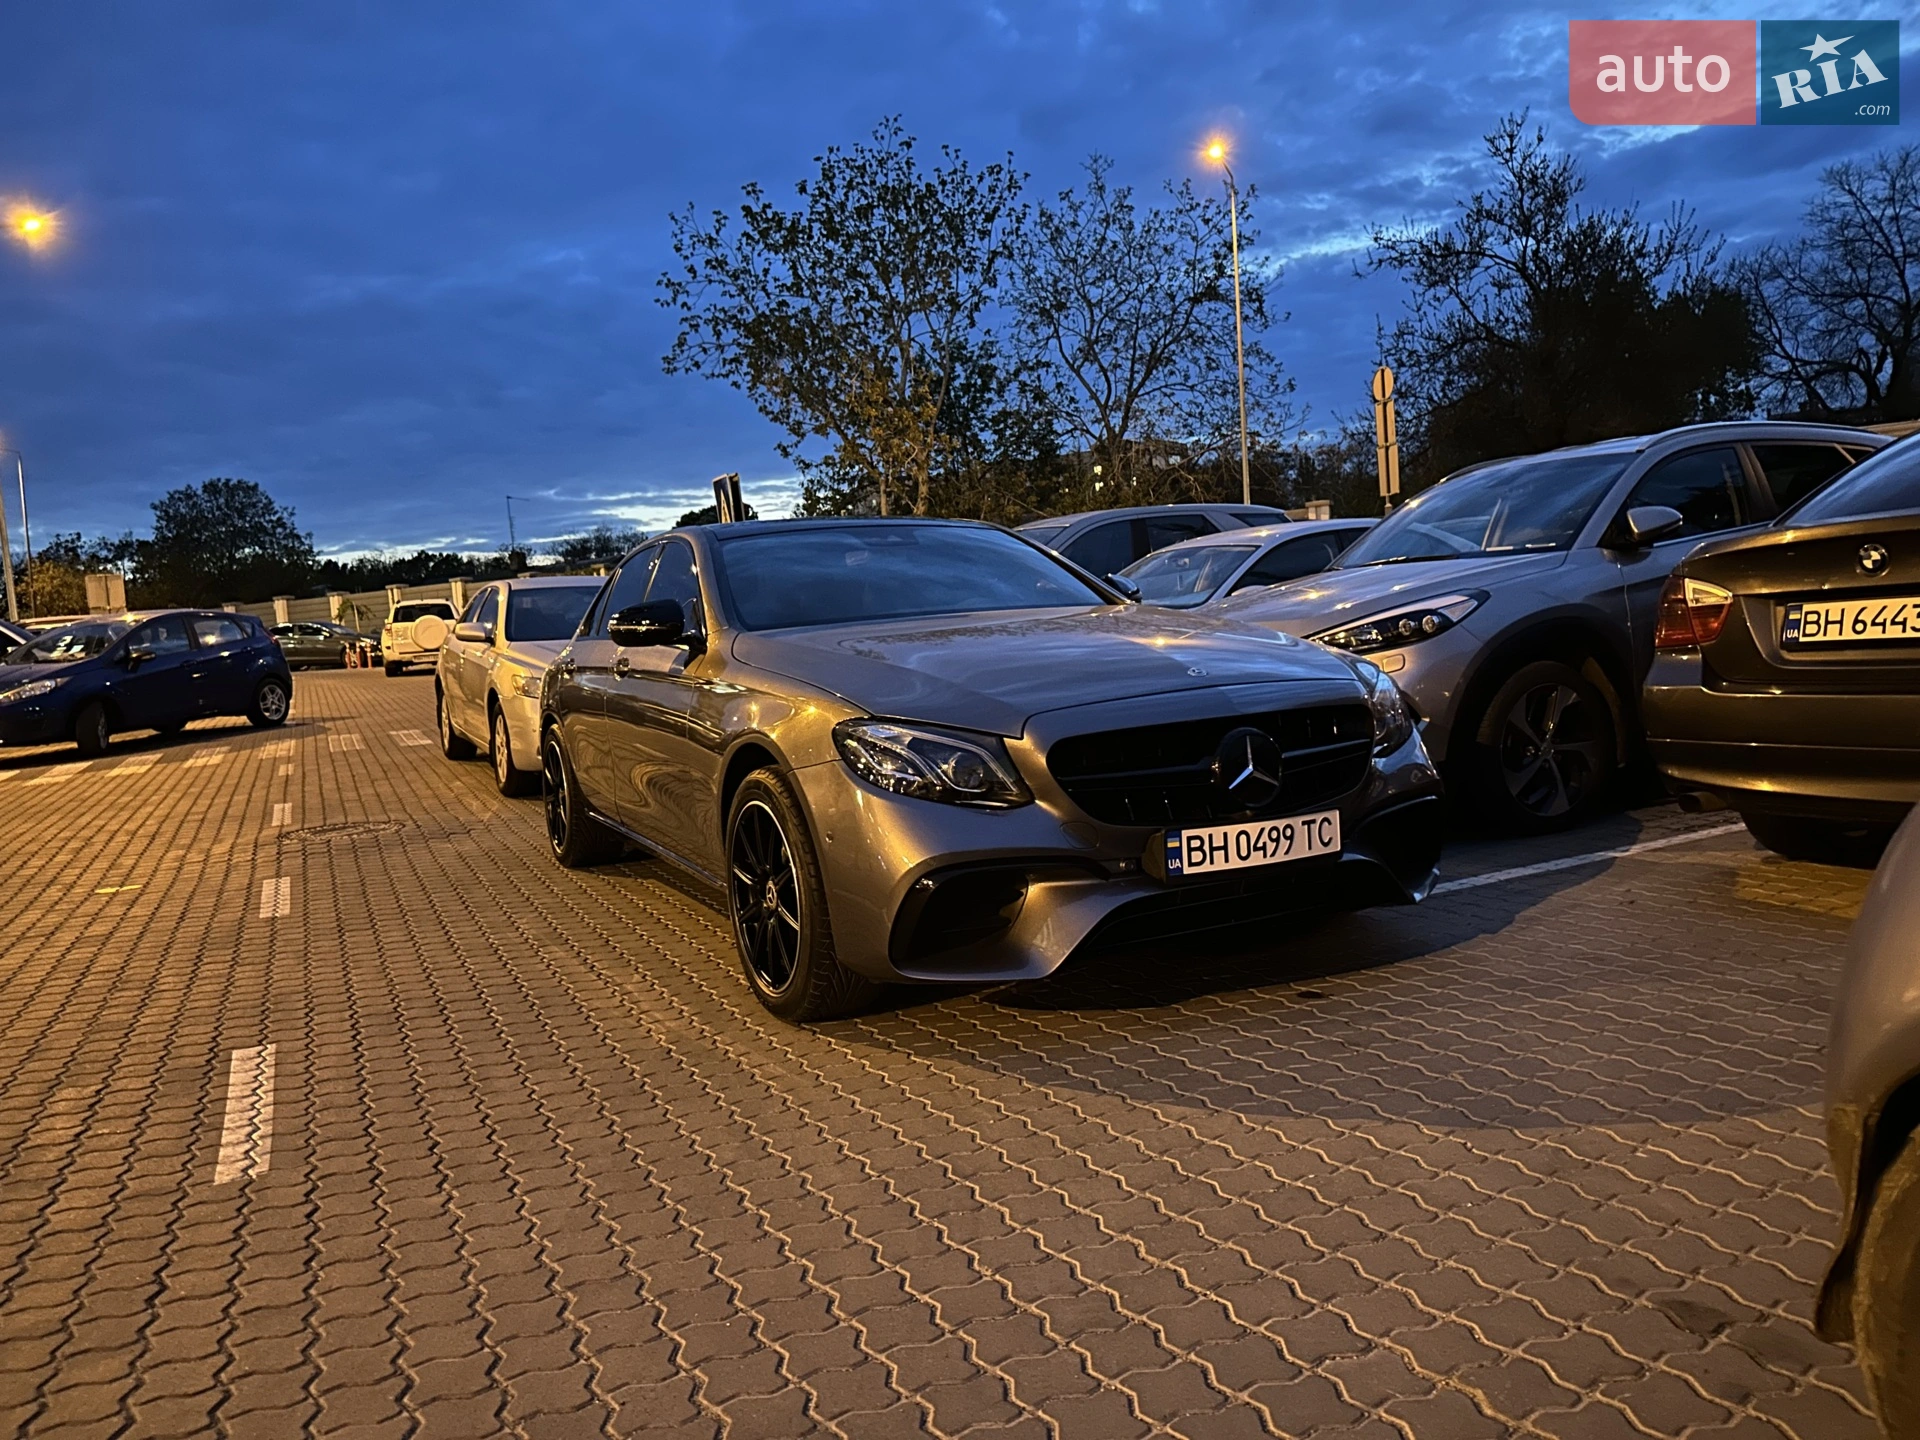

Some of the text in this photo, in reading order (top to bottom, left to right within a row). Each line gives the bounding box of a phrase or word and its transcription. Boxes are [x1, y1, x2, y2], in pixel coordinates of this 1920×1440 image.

[1801, 607, 1846, 638] BH
[1786, 629, 1799, 639] UA
[1186, 816, 1333, 868] BH 0499 TC
[1168, 858, 1182, 869] UA
